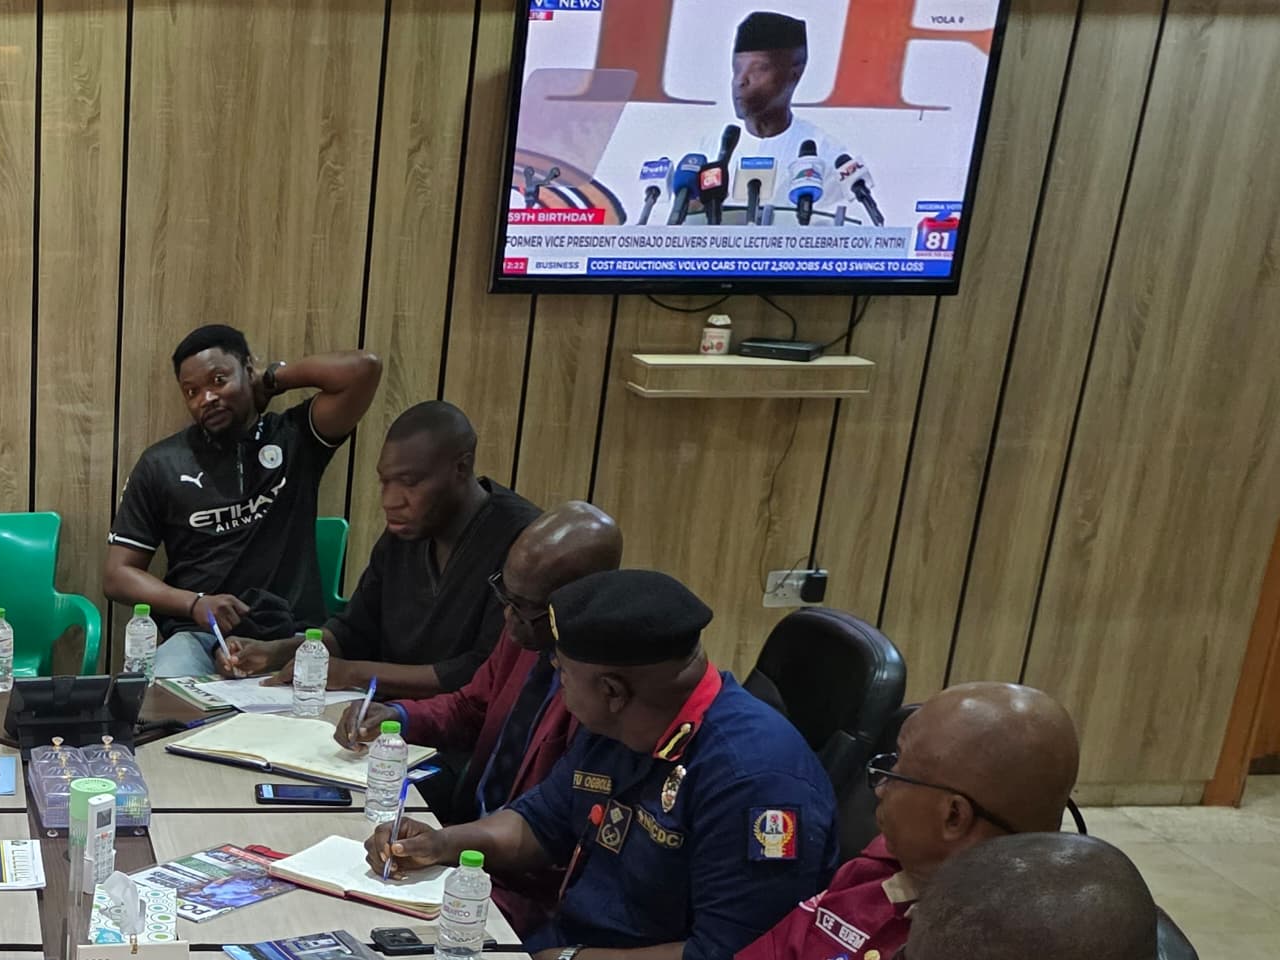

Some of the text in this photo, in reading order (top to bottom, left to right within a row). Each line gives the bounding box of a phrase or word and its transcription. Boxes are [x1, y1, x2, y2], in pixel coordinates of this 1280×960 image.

[507, 212, 595, 222] 59TH BIRTHDAY
[505, 235, 906, 249] FORMER VICE PRESIDENT OSINBAJO DELIVERS PUBLIC LECTURE TO CELEBRATE GOV. FINTIRI
[926, 231, 949, 250] 81
[535, 261, 579, 269] BUSINESS
[590, 261, 925, 272] COST REDUCTIONS: VOLVO CARS TO CUT 2,500 JOBS AS Q3 SWINGS TO LOSS
[822, 914, 836, 930] CE
